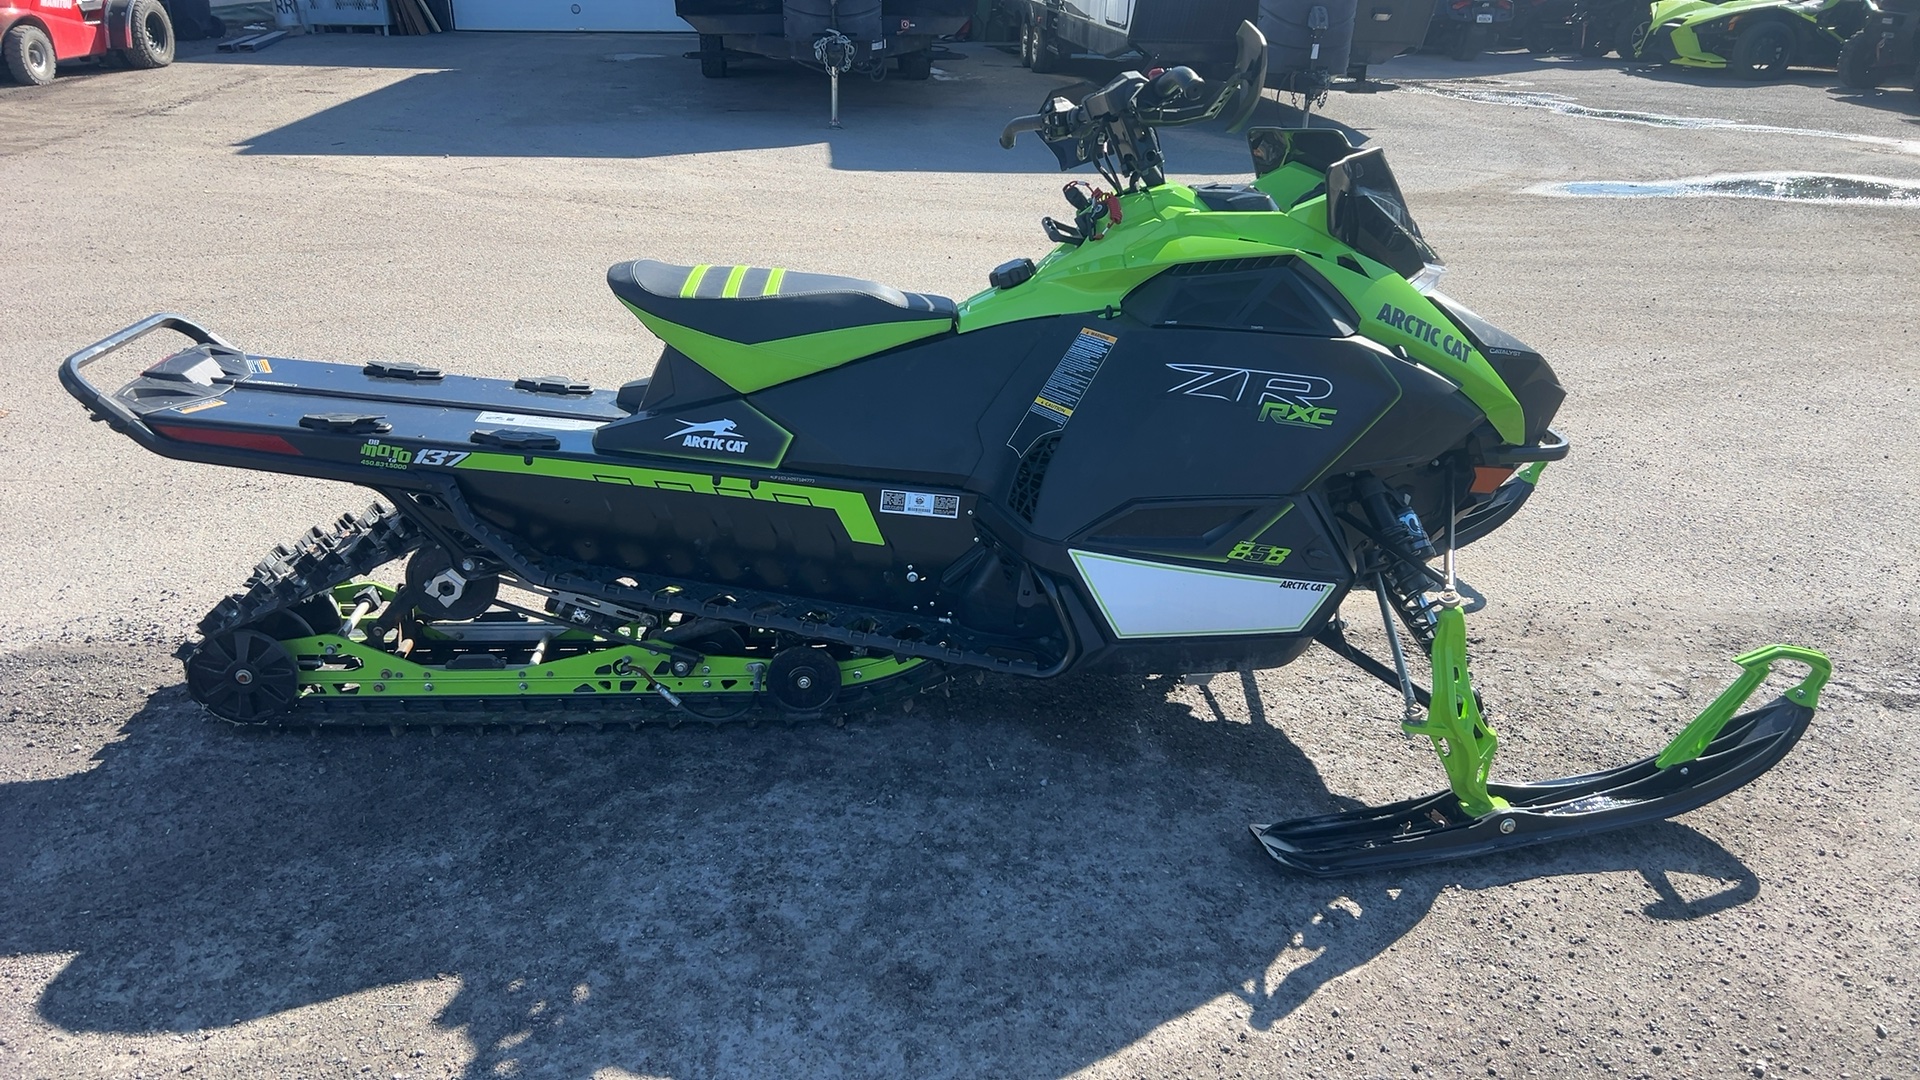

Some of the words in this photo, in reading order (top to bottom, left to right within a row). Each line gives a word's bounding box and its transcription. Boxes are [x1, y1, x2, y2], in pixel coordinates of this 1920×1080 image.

[1376, 303, 1441, 347] ARCTIC
[1443, 334, 1472, 363] CAT
[1489, 347, 1521, 357] CATALYST
[1165, 363, 1333, 409] ZR
[1258, 402, 1338, 428] RXC
[682, 434, 725, 450] ARCTIC
[726, 440, 748, 453] CAT
[413, 448, 471, 467] 137
[1227, 543, 1292, 564] 858
[1279, 580, 1309, 591] ARCTIC
[1310, 583, 1326, 592] CAT
